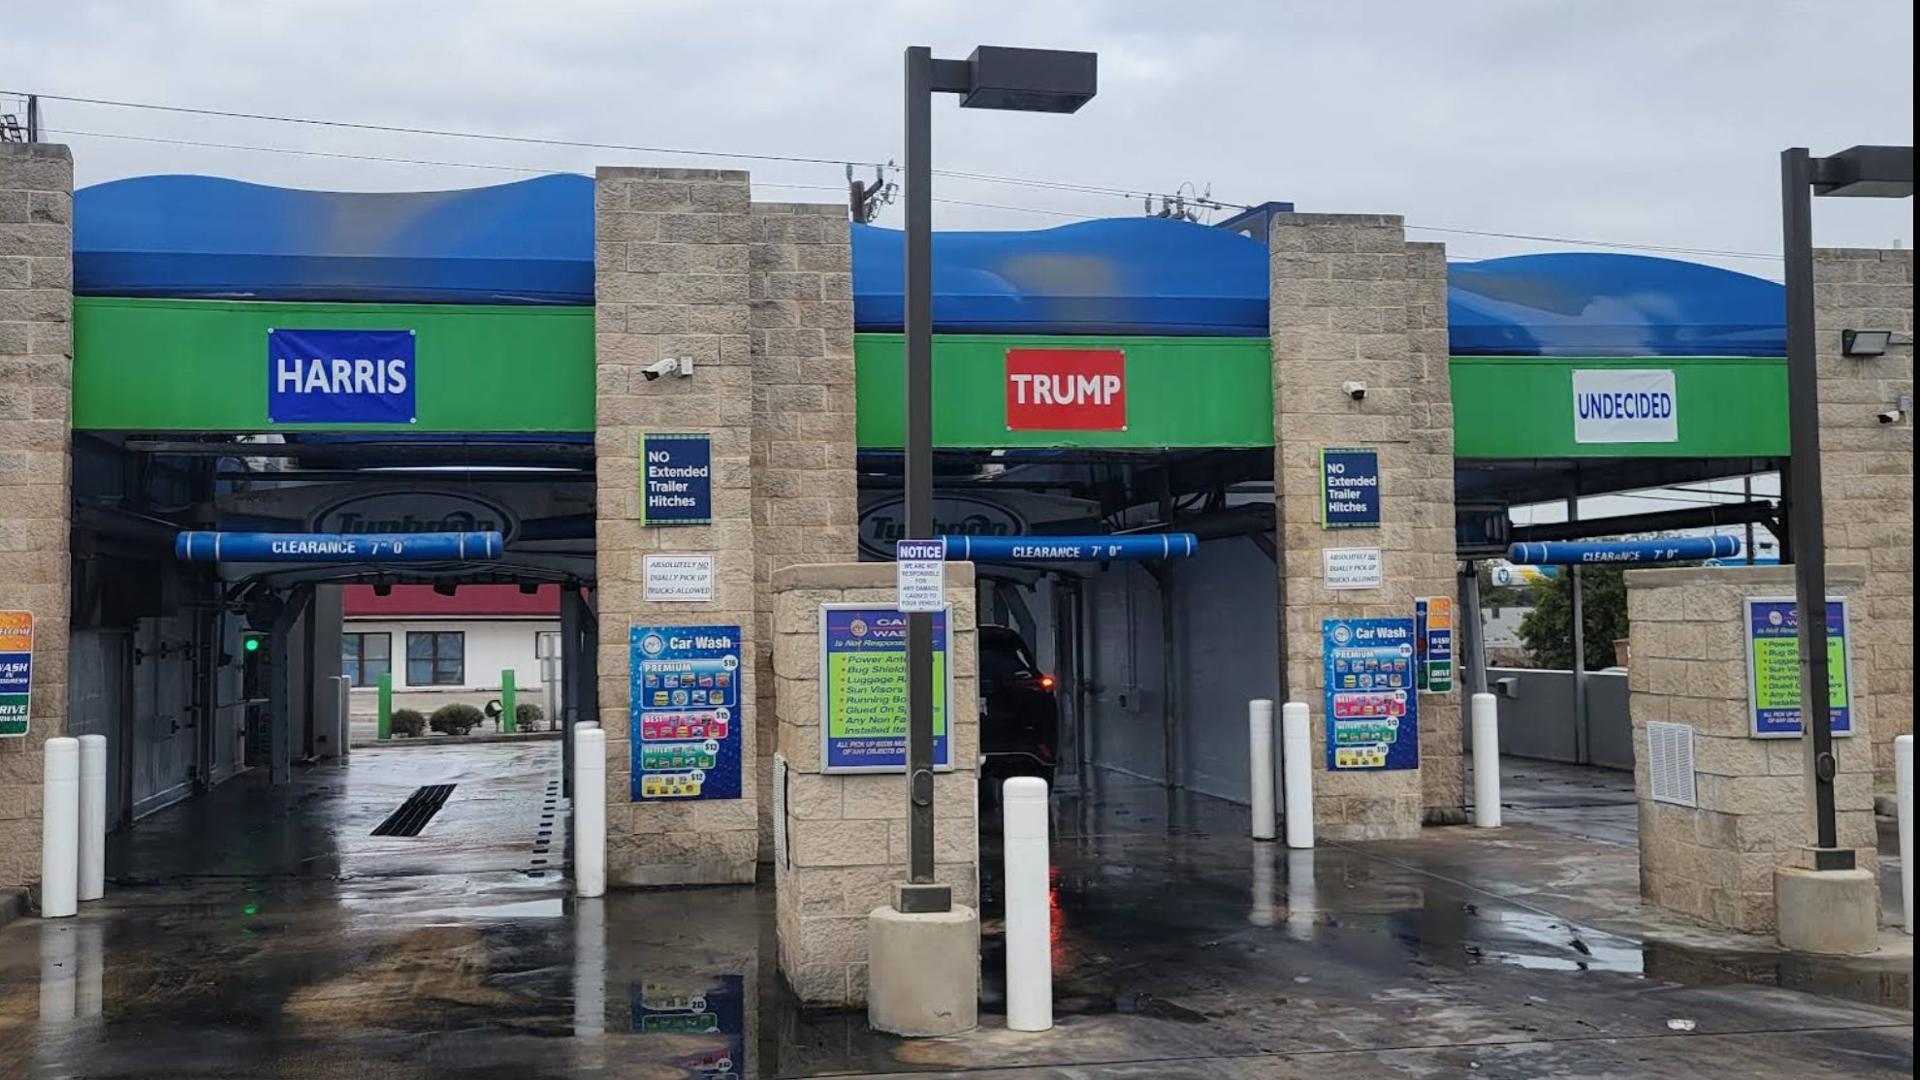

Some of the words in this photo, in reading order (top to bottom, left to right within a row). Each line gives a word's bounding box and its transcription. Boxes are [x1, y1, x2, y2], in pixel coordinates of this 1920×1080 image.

[277, 359, 407, 394] HARRIS
[1010, 374, 1121, 405] TRUMP
[1578, 392, 1672, 419] UNDECIDED
[649, 451, 670, 463] NO
[649, 465, 708, 477] Extended
[1327, 463, 1345, 474] NO
[648, 480, 688, 492] Trailer
[1327, 476, 1377, 487] Extended
[1328, 488, 1361, 499] Trailer
[649, 495, 696, 507] Hitches
[1328, 501, 1368, 512] Hitches
[272, 540, 356, 554] CLEARANCE
[900, 545, 942, 558] NOTICE
[1012, 546, 1080, 558] CLEARANCE
[1583, 551, 1641, 562] CLEARANCE
[697, 561, 710, 569] NO
[1356, 627, 1375, 639] Car
[1376, 626, 1407, 638] Wash
[670, 636, 693, 650] Car
[695, 635, 731, 649] Wash
[645, 663, 692, 672] PREMIUM
[723, 659, 736, 667] $16
[847, 666, 869, 674] Bug
[847, 676, 894, 685] Luggage
[846, 686, 867, 694] Sun
[871, 685, 904, 694] Visors
[846, 696, 890, 705] Running
[0, 704, 27, 714] RIVE
[845, 706, 877, 715] Glued
[880, 706, 894, 714] On
[845, 716, 867, 725] Any
[690, 773, 704, 781] $12
